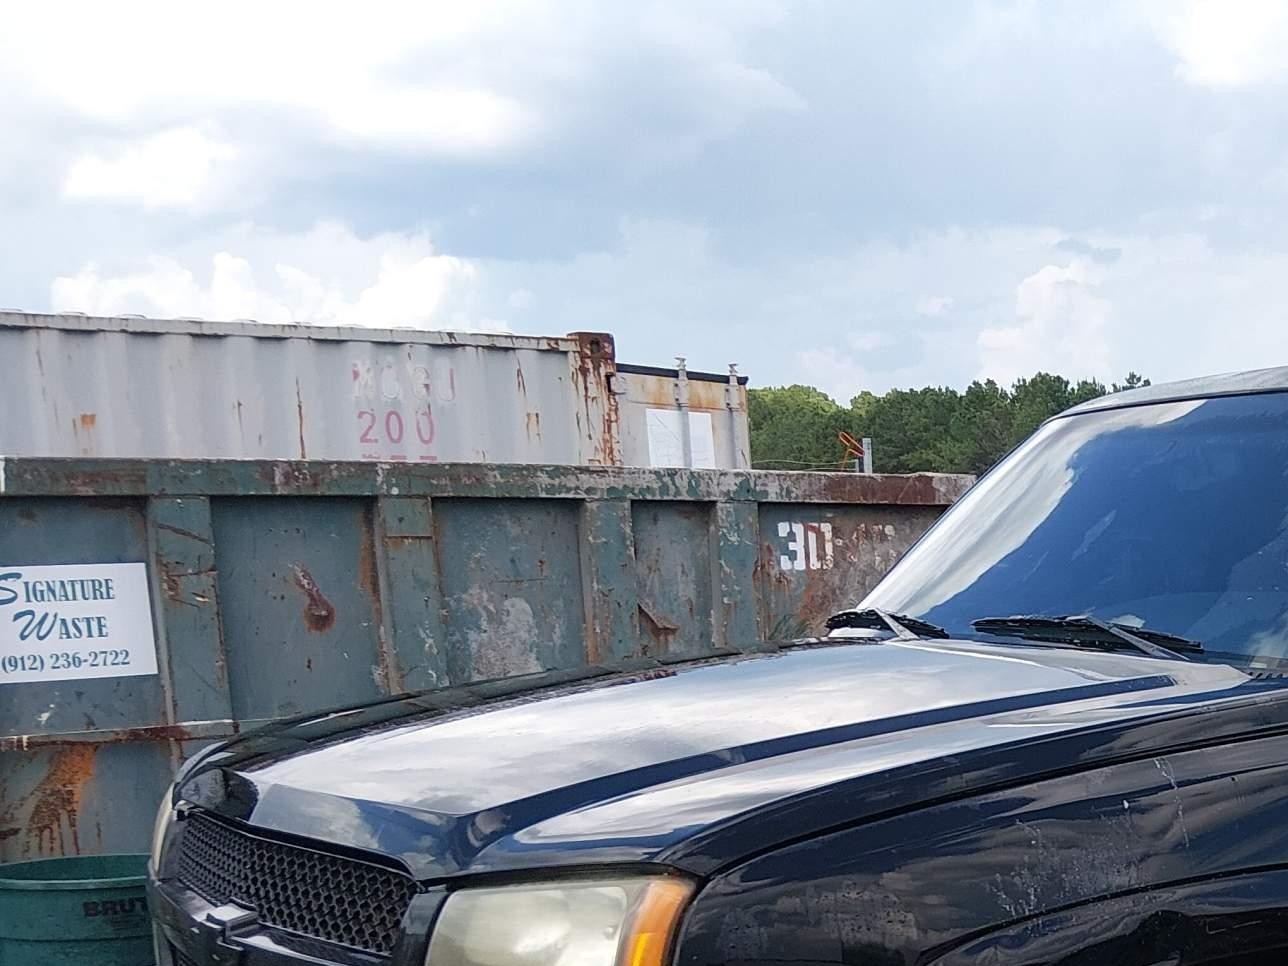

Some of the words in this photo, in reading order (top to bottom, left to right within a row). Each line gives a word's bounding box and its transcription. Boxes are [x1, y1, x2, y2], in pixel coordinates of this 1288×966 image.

[0, 572, 116, 606] SIGNATURE
[12, 609, 109, 641] WASTE
[2, 654, 44, 673] (912)
[50, 649, 130, 670] 236-2722
